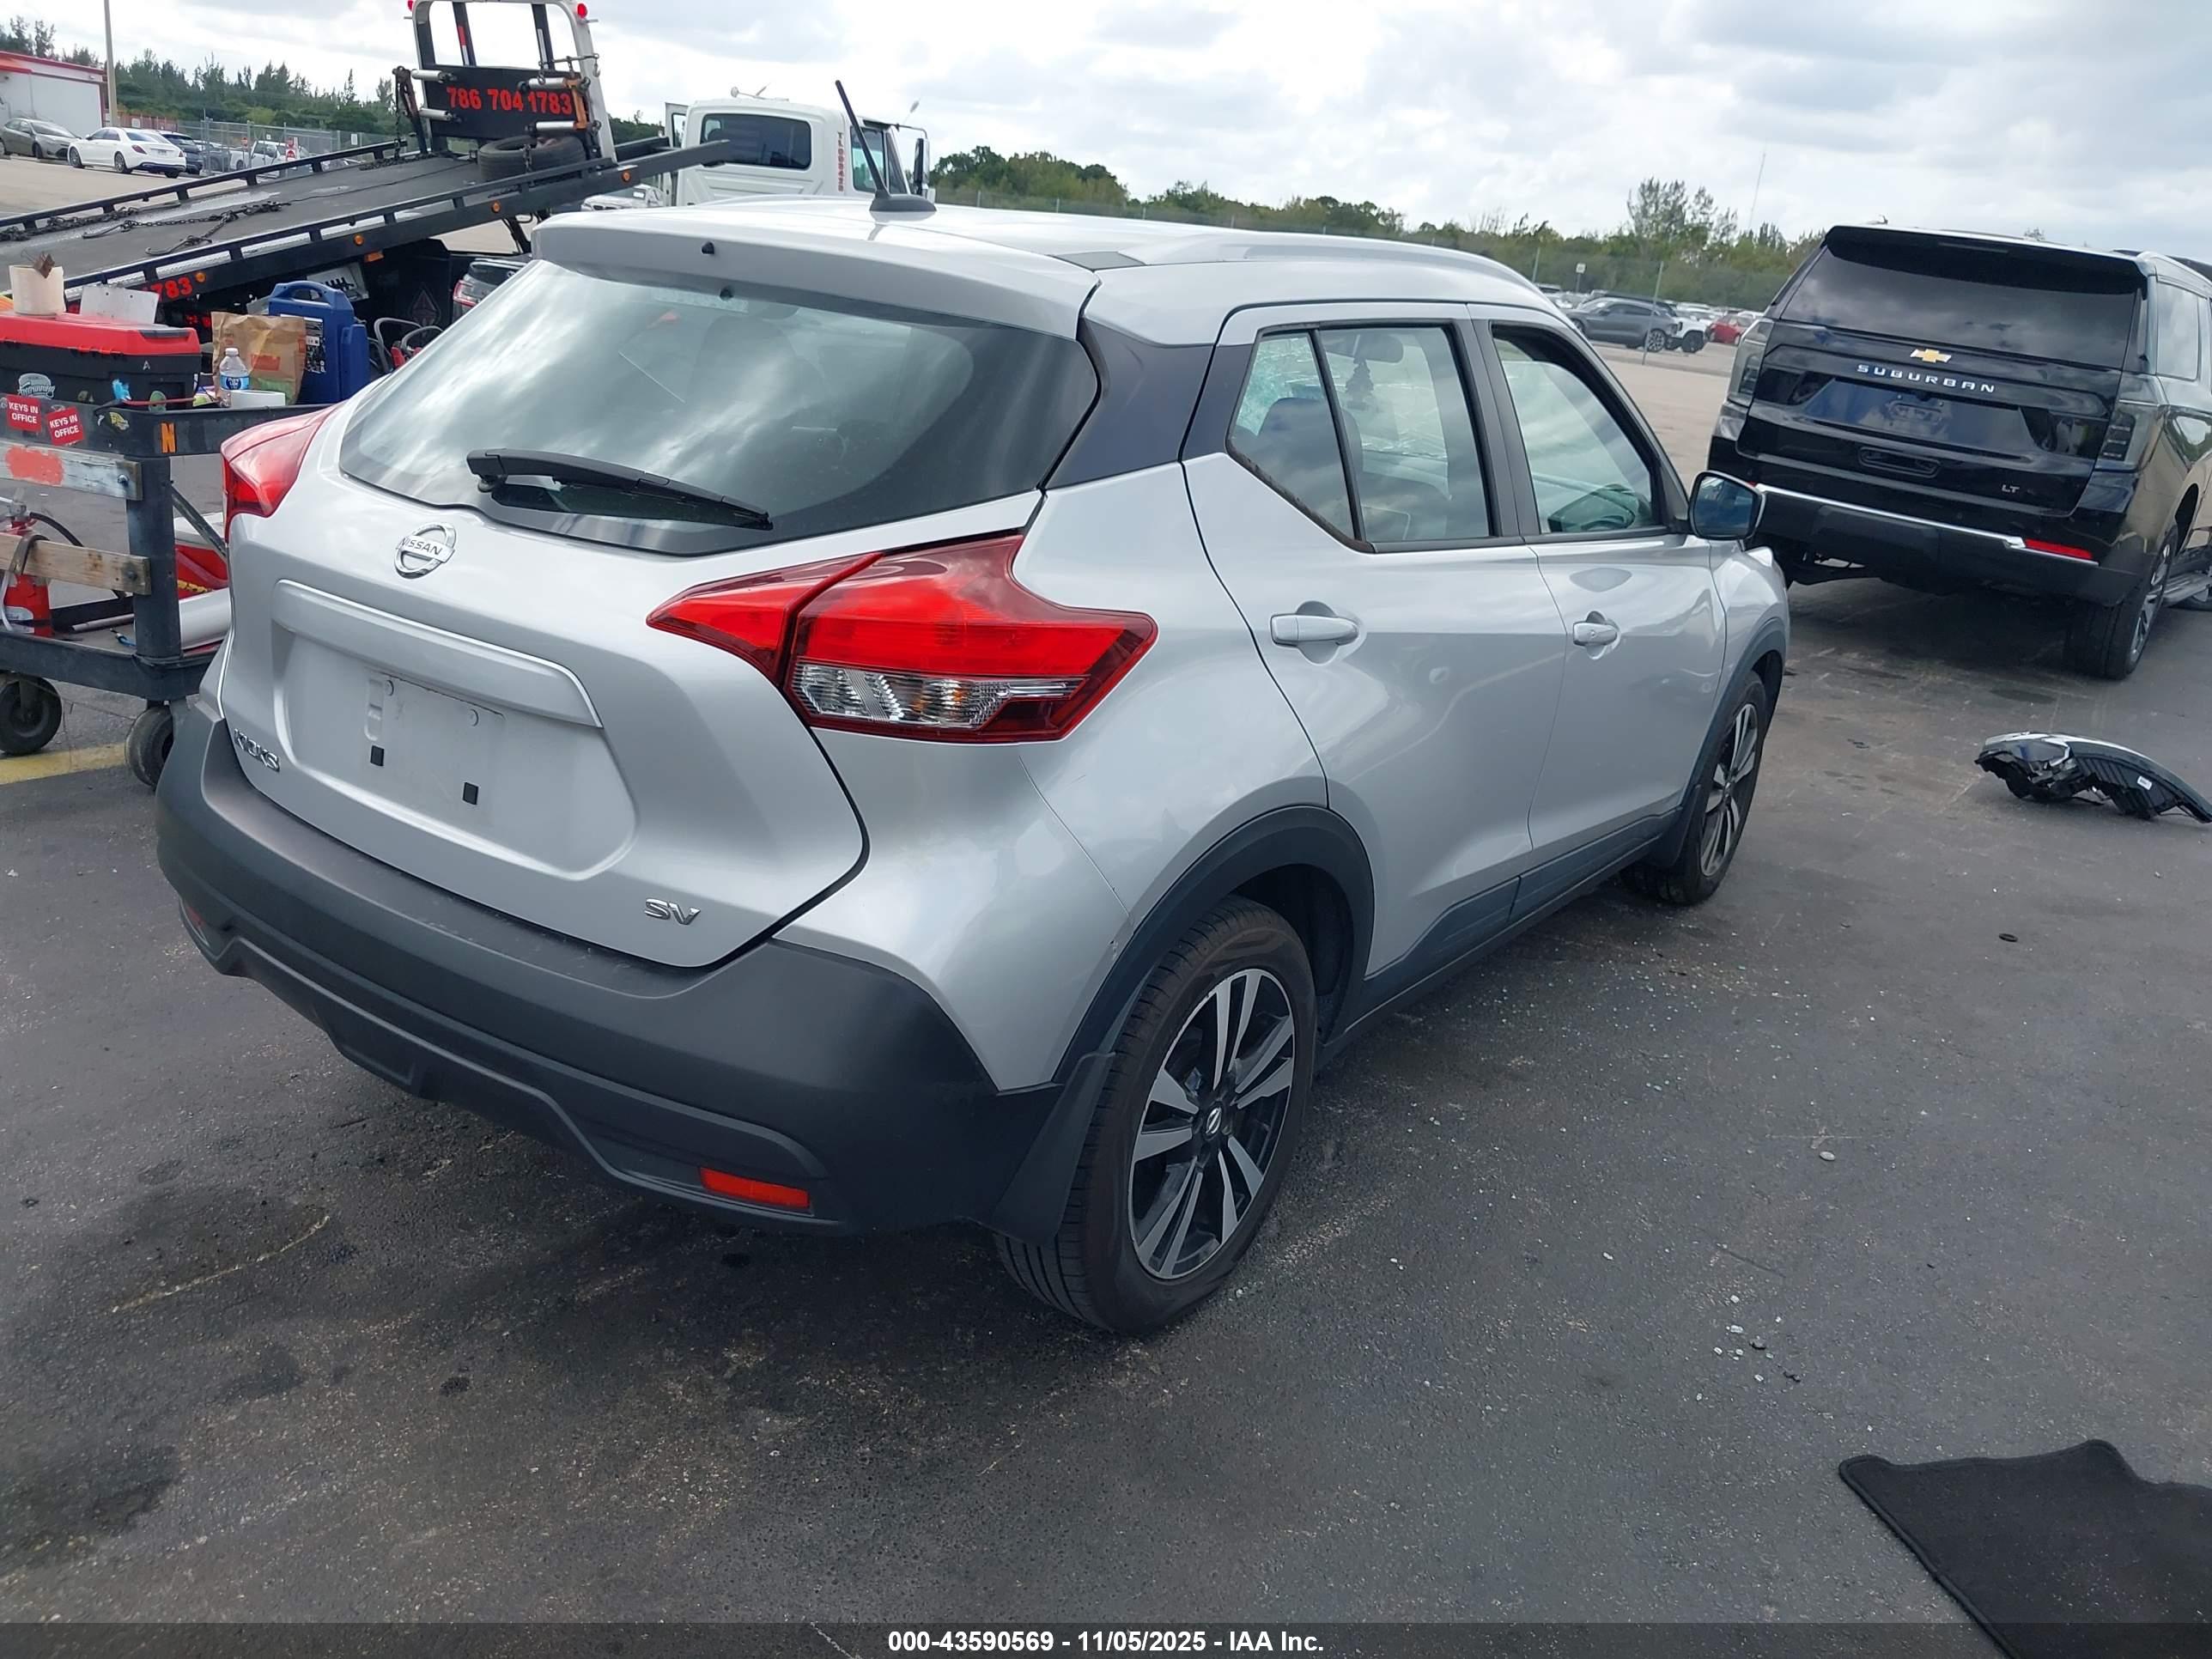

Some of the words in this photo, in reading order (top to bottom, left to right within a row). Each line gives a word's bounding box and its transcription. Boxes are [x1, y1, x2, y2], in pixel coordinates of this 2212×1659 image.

[447, 87, 482, 110] 786
[487, 88, 523, 112] 704
[527, 91, 572, 115] 1783
[1856, 364, 1995, 393] SUBURBAN
[9, 402, 28, 412] KEYS
[30, 404, 39, 414] IN
[11, 414, 37, 424] OFFICE
[49, 416, 69, 428] KEYS
[70, 414, 78, 422] IN
[54, 425, 79, 438] OFFICE
[161, 422, 176, 453] N
[2002, 483, 2020, 494] LT
[401, 536, 443, 556] NISSAN
[234, 728, 280, 772] KICKS
[644, 897, 702, 926] SV
